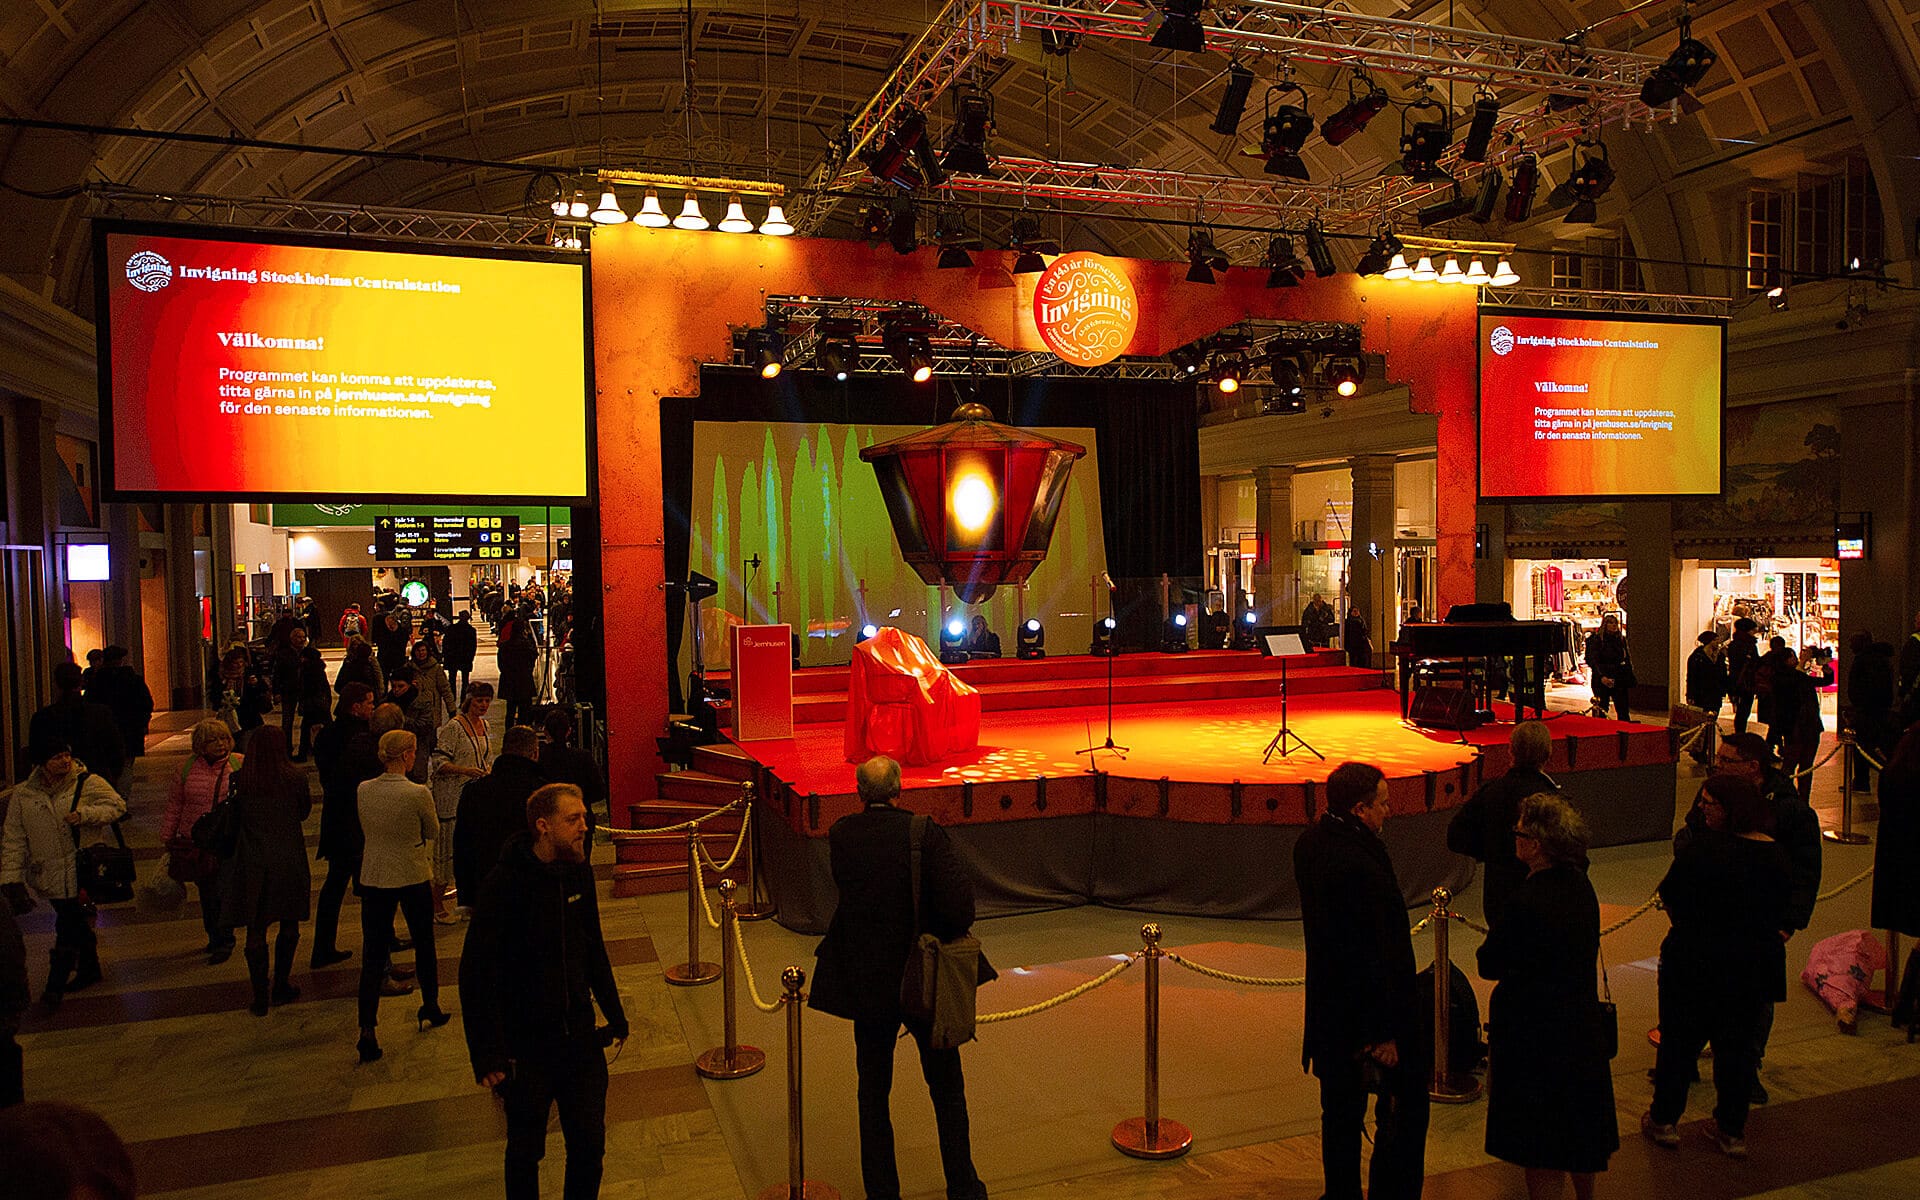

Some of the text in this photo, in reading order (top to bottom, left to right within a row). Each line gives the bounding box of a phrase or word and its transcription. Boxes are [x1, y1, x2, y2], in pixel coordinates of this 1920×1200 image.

[179, 265, 258, 284] Invigning
[260, 270, 352, 288] Stockholms
[353, 276, 461, 294] Centralstation
[1043, 278, 1057, 294] En
[1053, 263, 1070, 280] 143
[1041, 287, 1132, 324] Invigning
[216, 332, 325, 351] Välkomna!
[1516, 335, 1557, 348] Invigning
[1556, 337, 1604, 347] Stockholms
[218, 367, 497, 391] Programmet kan komma att uppdateras,
[1534, 381, 1589, 393] Välkomna!
[218, 384, 252, 397] titta
[254, 386, 296, 401] gärna
[298, 387, 312, 399] in
[314, 387, 333, 402] på
[218, 400, 434, 419] för den senaste informationen.
[1534, 406, 1581, 418] Programmet
[1580, 407, 1595, 417] kan
[1595, 407, 1622, 417] komma
[1622, 408, 1634, 417] att
[1534, 418, 1551, 428] titta
[1551, 418, 1573, 430] gärna
[1573, 418, 1582, 428] in
[1582, 418, 1592, 429] på
[1534, 430, 1546, 440] för
[1546, 430, 1561, 440] den
